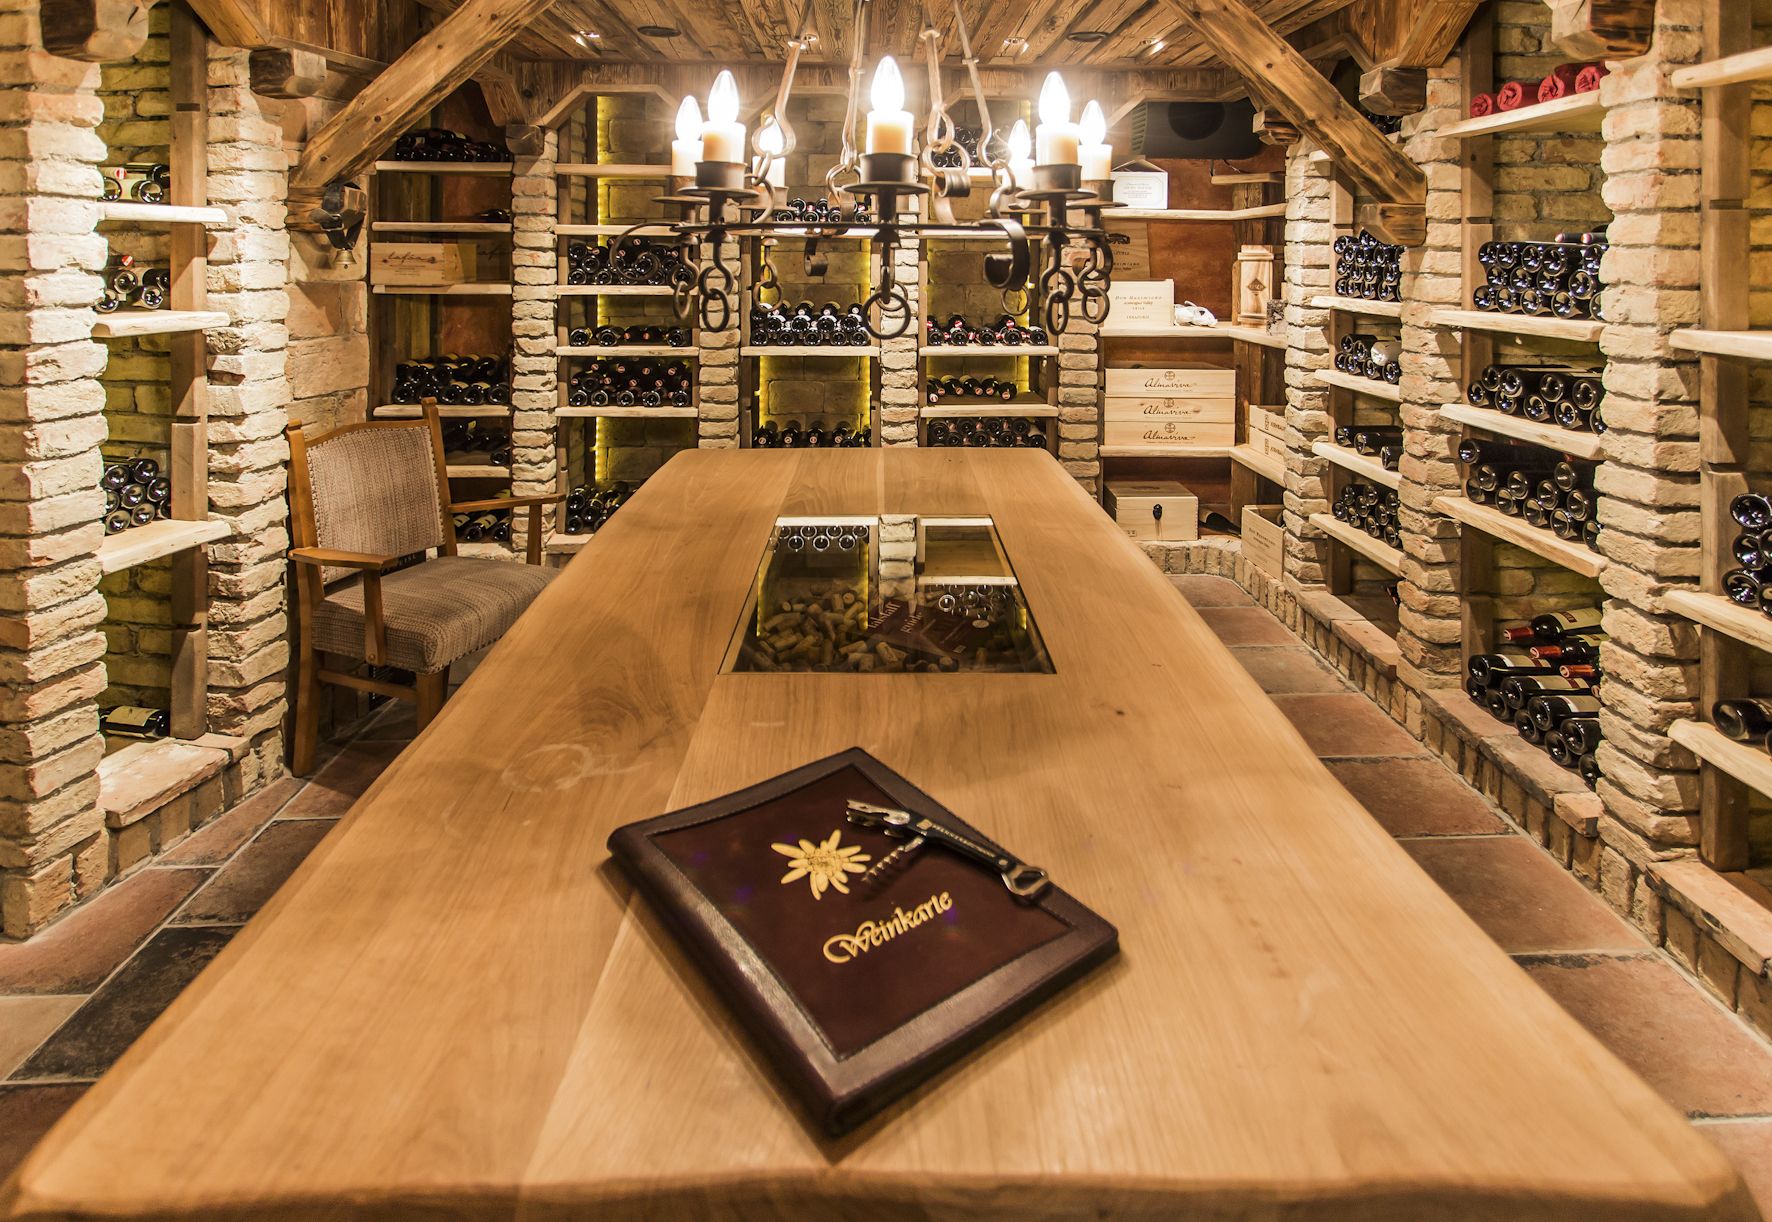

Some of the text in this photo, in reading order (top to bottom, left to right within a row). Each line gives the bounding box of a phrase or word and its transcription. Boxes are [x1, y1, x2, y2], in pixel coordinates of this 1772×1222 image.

[1144, 377, 1193, 388] Almaviva
[1143, 404, 1192, 415] Almaviva
[1143, 430, 1195, 441] Almaviva
